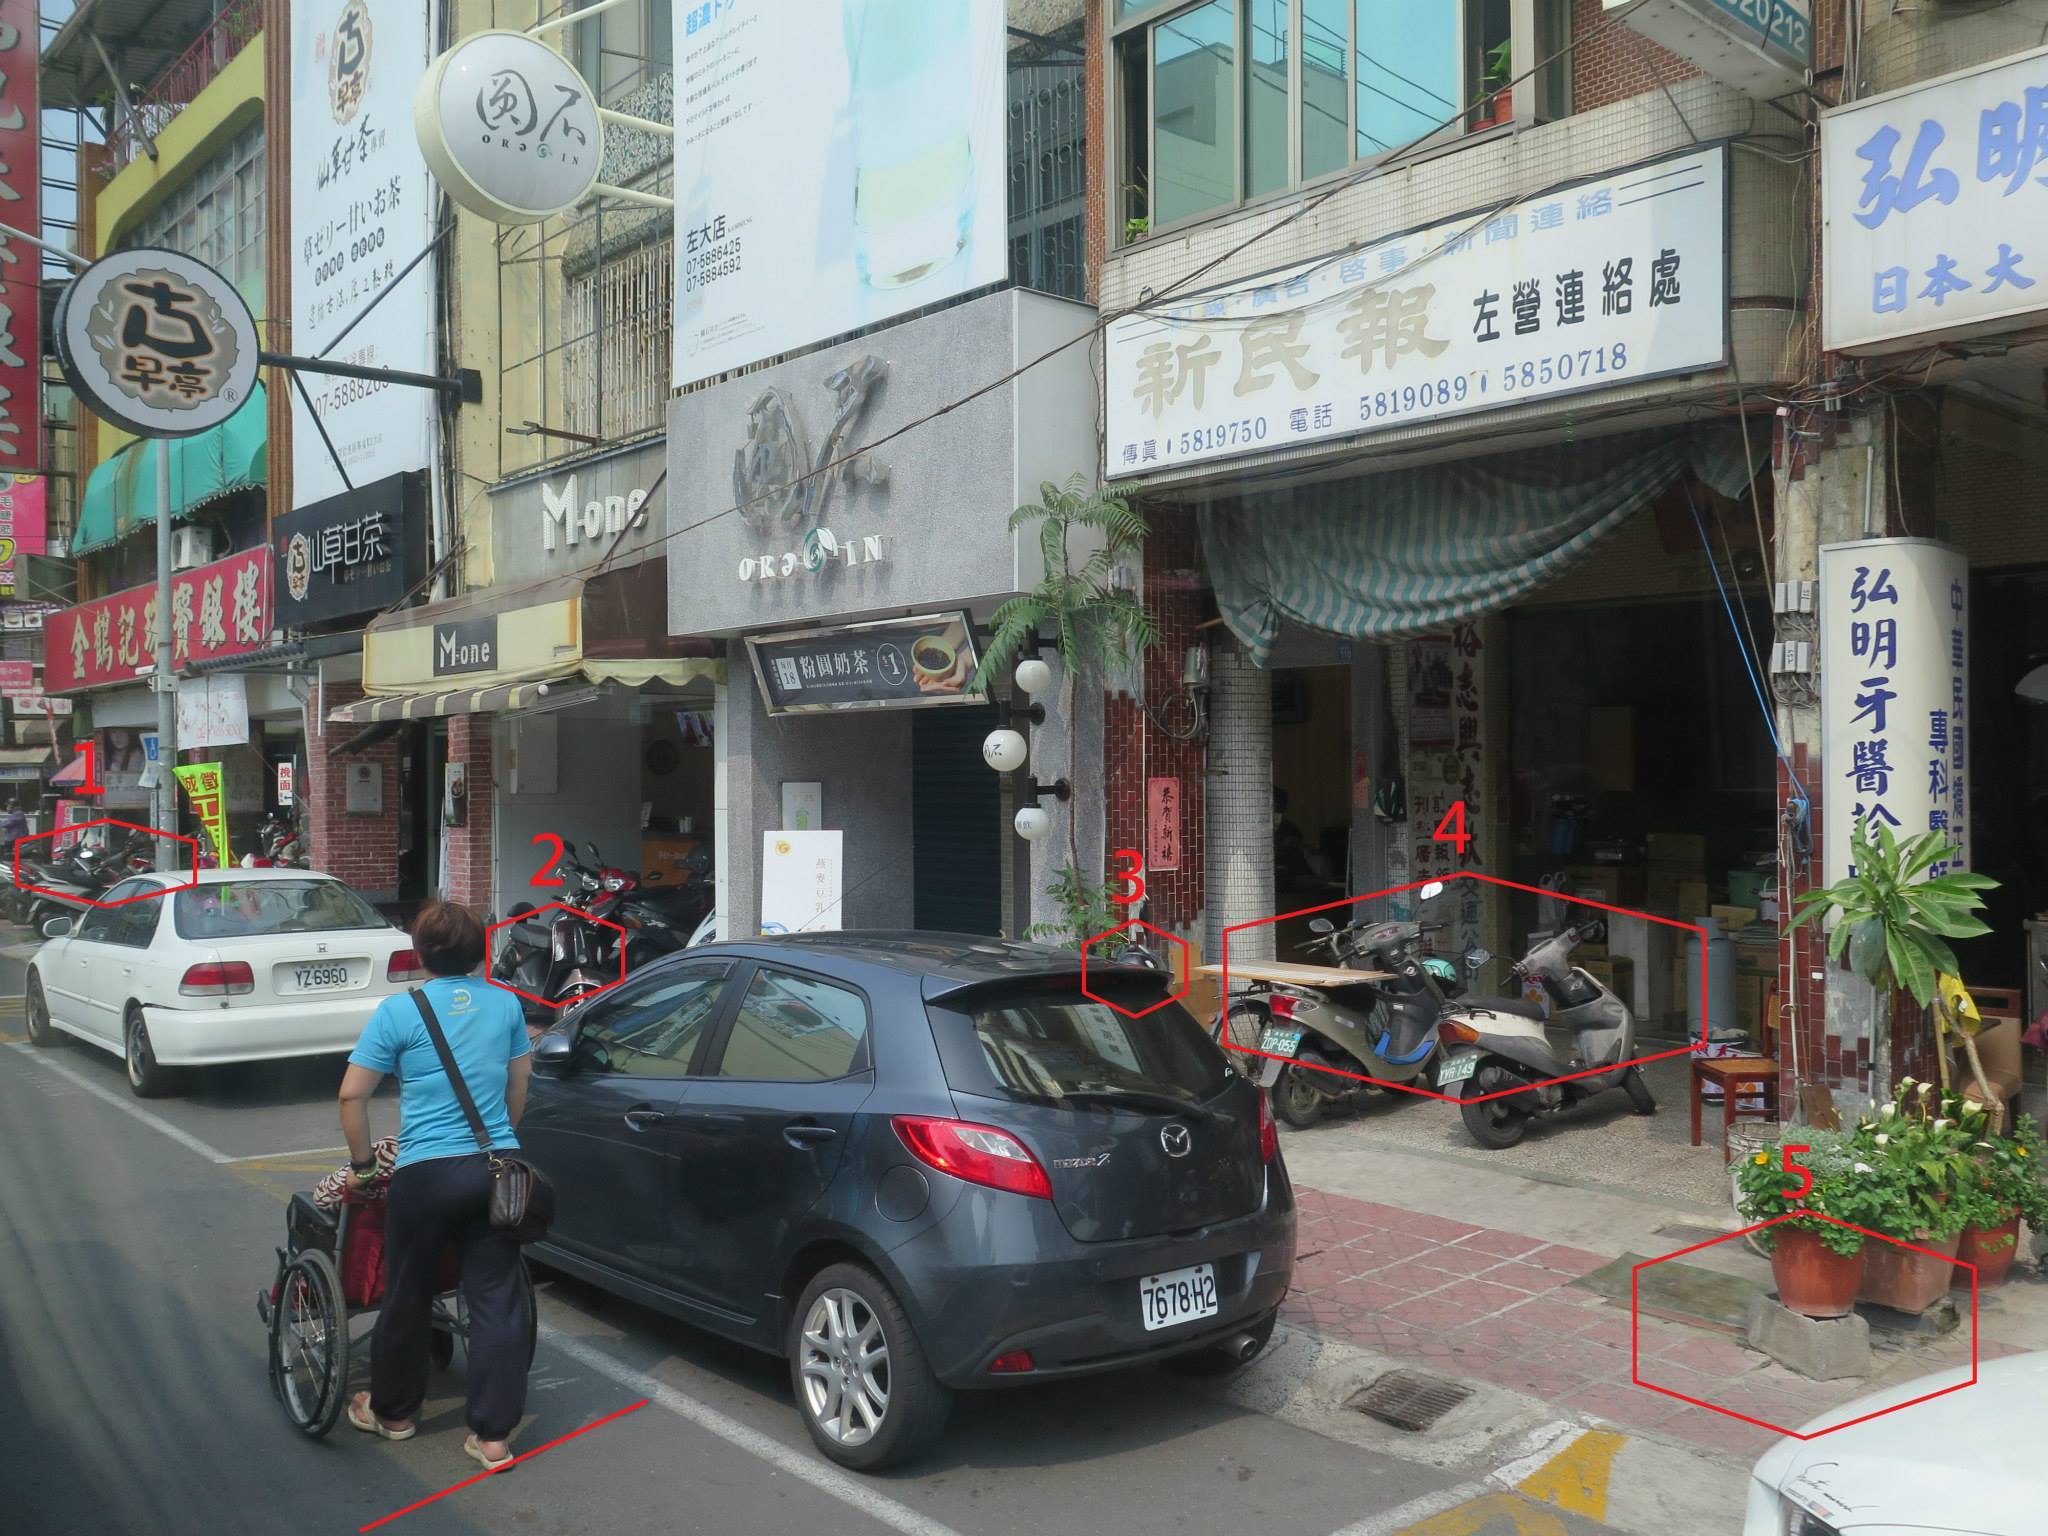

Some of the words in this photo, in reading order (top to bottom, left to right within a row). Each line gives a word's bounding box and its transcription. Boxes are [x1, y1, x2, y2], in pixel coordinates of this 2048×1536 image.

[1727, 0, 1806, 55] 20212
[686, 214, 726, 254] 左大店
[686, 237, 741, 275] 07-5886425
[686, 255, 741, 293] 07-5884592
[1472, 248, 1682, 344] 左營連絡處
[1872, 244, 2036, 315] 日本大
[1132, 282, 1450, 418] 新民報
[1180, 416, 1268, 455] 5819750
[1289, 402, 1332, 432] 電話
[1359, 375, 1468, 420] 5819089
[1503, 342, 1627, 392] 5850718
[799, 649, 870, 679] 粉圓奶茶
[1845, 566, 1902, 887] 弘明牙醫診
